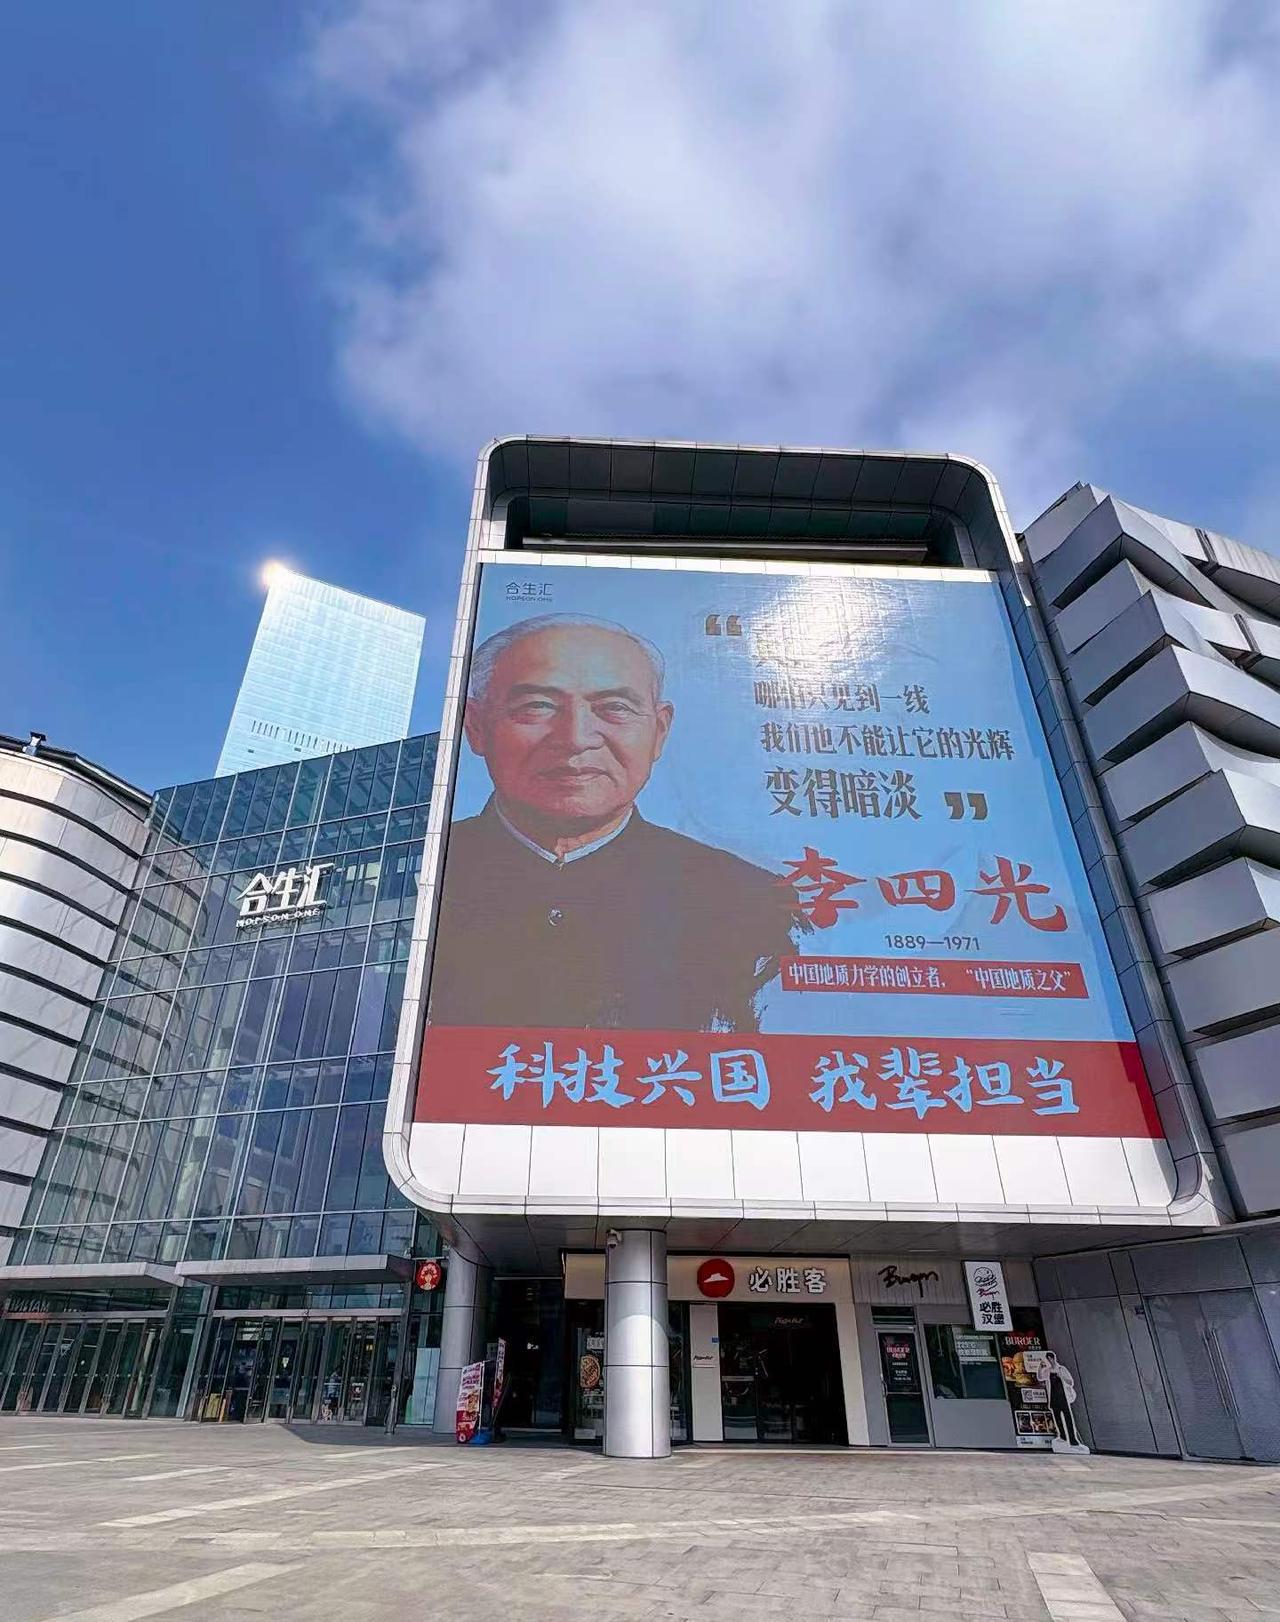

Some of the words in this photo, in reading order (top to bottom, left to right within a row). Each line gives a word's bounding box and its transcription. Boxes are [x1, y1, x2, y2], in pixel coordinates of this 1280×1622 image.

[505, 582, 553, 596] 合生汇
[760, 722, 1015, 761] 我们也不能让它的光辉
[765, 766, 922, 820] 变得暗淡
[236, 863, 335, 916] 合生汇
[776, 847, 1068, 932] 李四光
[486, 1042, 771, 1110] 科技兴国
[809, 1047, 1079, 1119] 我辈担当
[749, 1266, 827, 1294] 必胜客
[979, 1301, 1003, 1313] 必胜
[981, 1313, 1005, 1325] 汉堡
